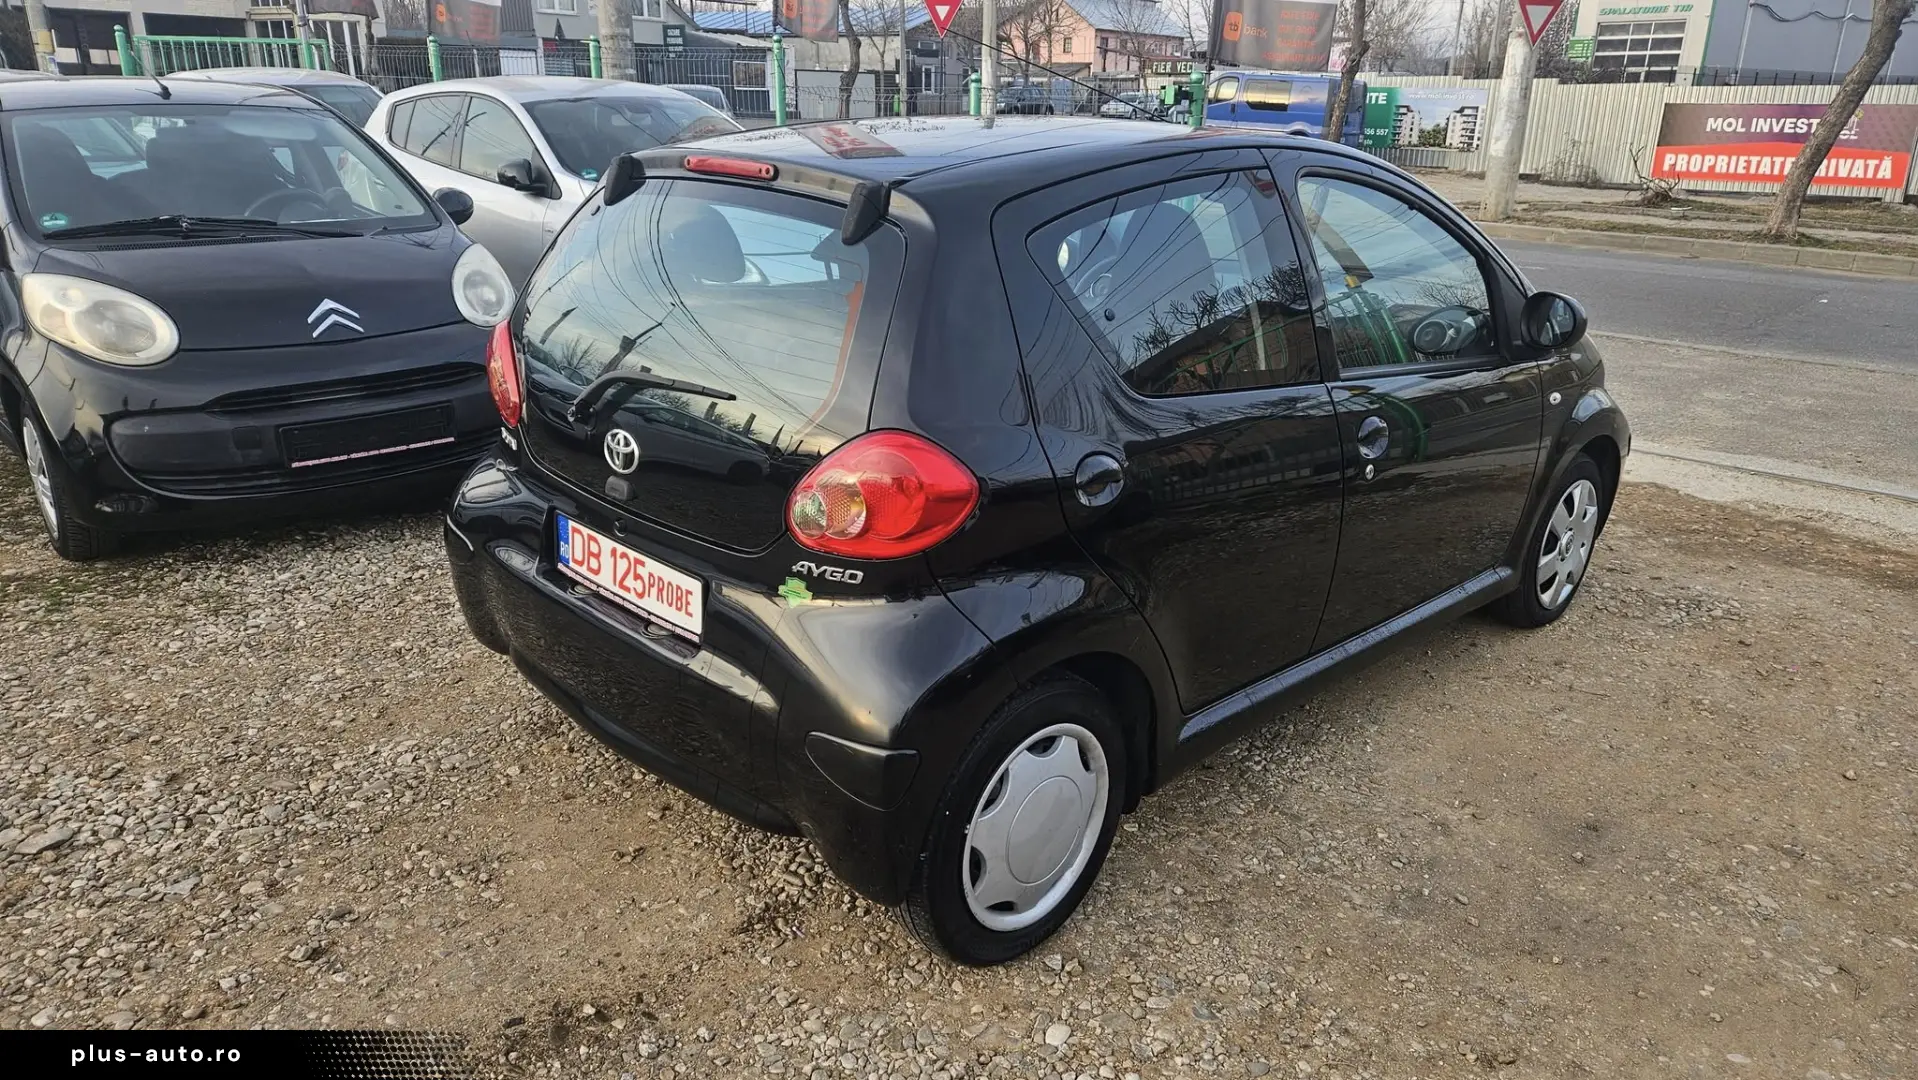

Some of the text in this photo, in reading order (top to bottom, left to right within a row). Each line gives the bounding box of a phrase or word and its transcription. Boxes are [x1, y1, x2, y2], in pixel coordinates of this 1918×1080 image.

[1673, 4, 1694, 13] TIR
[1244, 23, 1268, 39] bank
[1153, 61, 1171, 73] FIER
[1376, 128, 1389, 136] 557
[1706, 117, 1821, 134] MOL INVEST
[1814, 156, 1893, 179] RIVATĂ
[571, 525, 602, 576] DB
[610, 546, 646, 600] 125
[647, 572, 693, 618] PROBE
[791, 561, 864, 584] AYGO
